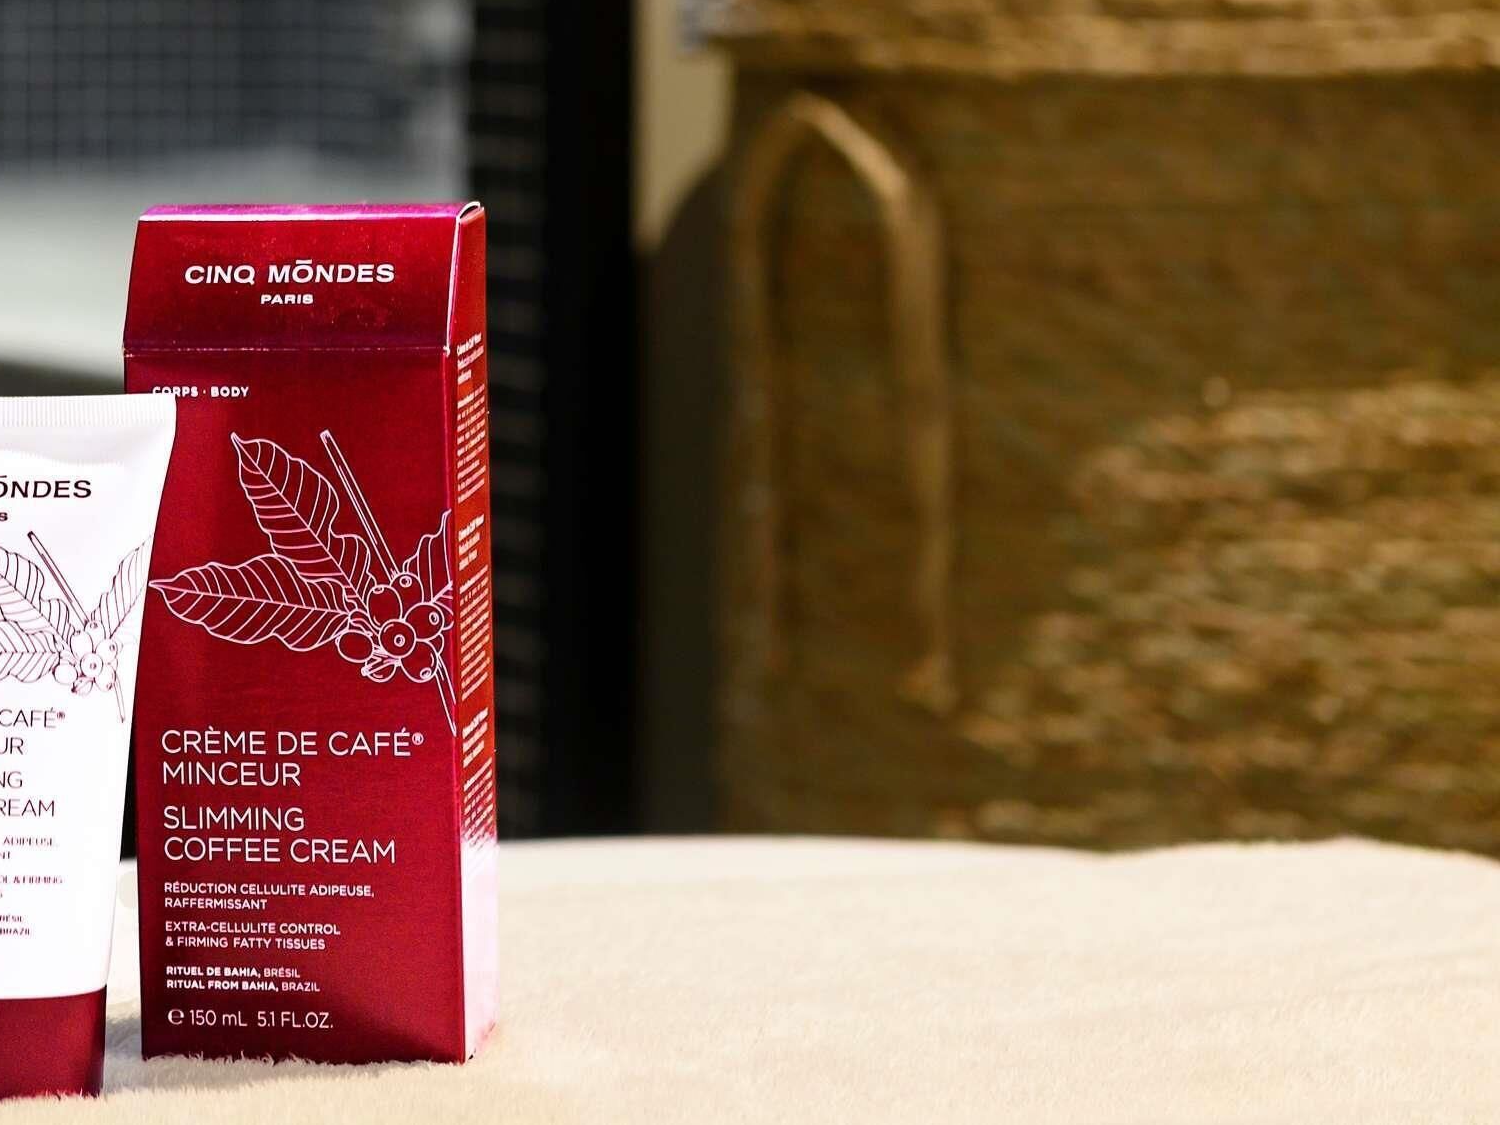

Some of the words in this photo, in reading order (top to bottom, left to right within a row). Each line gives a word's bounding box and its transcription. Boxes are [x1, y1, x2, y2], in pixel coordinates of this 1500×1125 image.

[185, 266, 255, 285] CINQ
[260, 294, 314, 305] PARIS
[152, 386, 199, 397] CORPS
[211, 386, 249, 398] BODY
[161, 726, 266, 755] CRÈME
[277, 731, 318, 756] DE
[162, 761, 301, 787] MINCEUR
[163, 805, 305, 832] SLIMMING
[164, 836, 282, 863] COFFEE
[290, 839, 397, 865] CREAM
[164, 882, 236, 894] RÉDUCTION
[240, 883, 306, 897] CELLULITE
[309, 884, 376, 898] ADIPEUSE,
[164, 898, 268, 910] RAFFERMISSANT
[165, 921, 276, 933] EXTRA-CELLULITE
[279, 923, 341, 936] CONTROL
[165, 936, 174, 948] &
[177, 936, 229, 949] FIRMING
[233, 937, 271, 950] FATTY
[275, 938, 326, 951] TISSUES
[166, 966, 204, 977] RITUEL
[206, 967, 222, 977] DE
[224, 967, 262, 979] BAHIA,
[263, 966, 301, 979] BRÉSIL
[166, 980, 205, 991] RITUAL
[208, 981, 239, 992] FROM
[242, 981, 280, 993] BAHIA,
[282, 982, 321, 993] BRAZIL
[189, 1009, 217, 1026] 150
[222, 1009, 248, 1027] mL
[257, 1010, 276, 1027] 5.1
[281, 1011, 334, 1029] FL.OZ.
